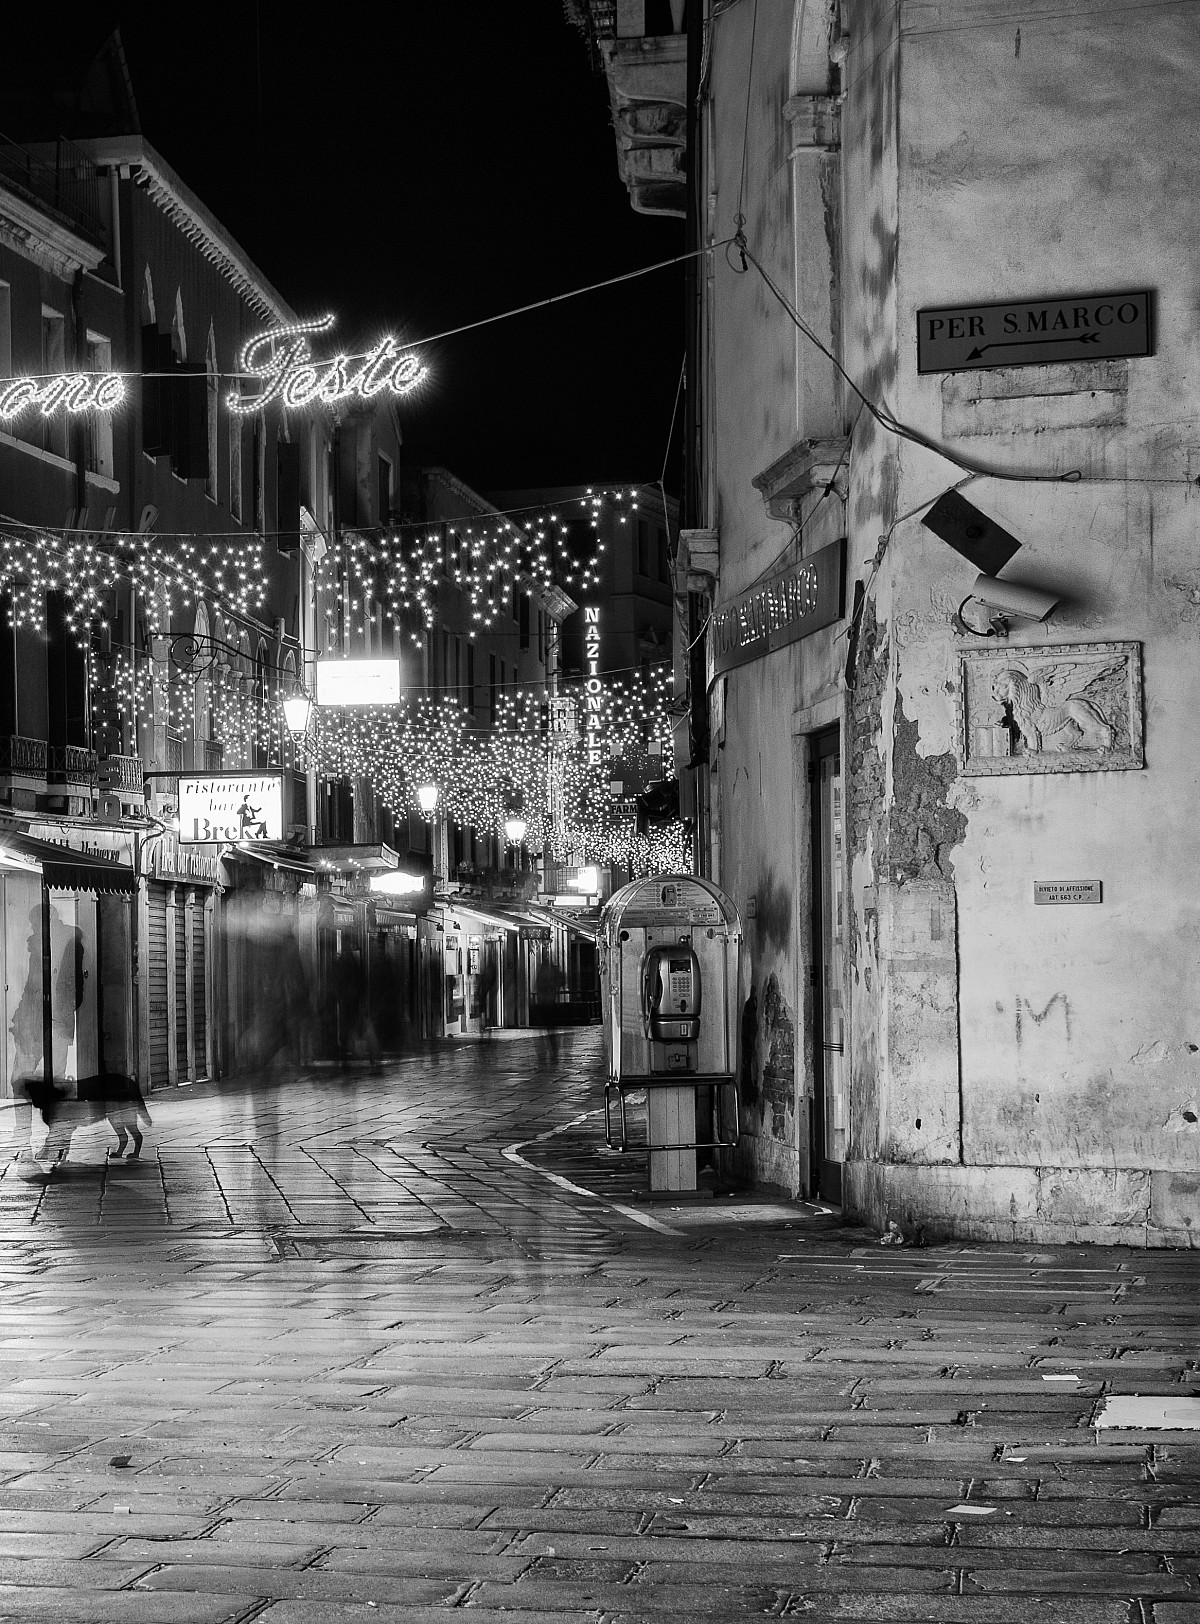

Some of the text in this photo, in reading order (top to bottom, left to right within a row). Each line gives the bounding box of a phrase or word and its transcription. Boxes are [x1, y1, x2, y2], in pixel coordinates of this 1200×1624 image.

[928, 302, 1139, 341] PER S.MARCO
[225, 313, 430, 415] Feste
[584, 606, 602, 765] NAZIONALE
[185, 780, 276, 794] ristorante
[209, 798, 237, 812] bar
[611, 803, 638, 815] FARM
[192, 817, 256, 841] Brek
